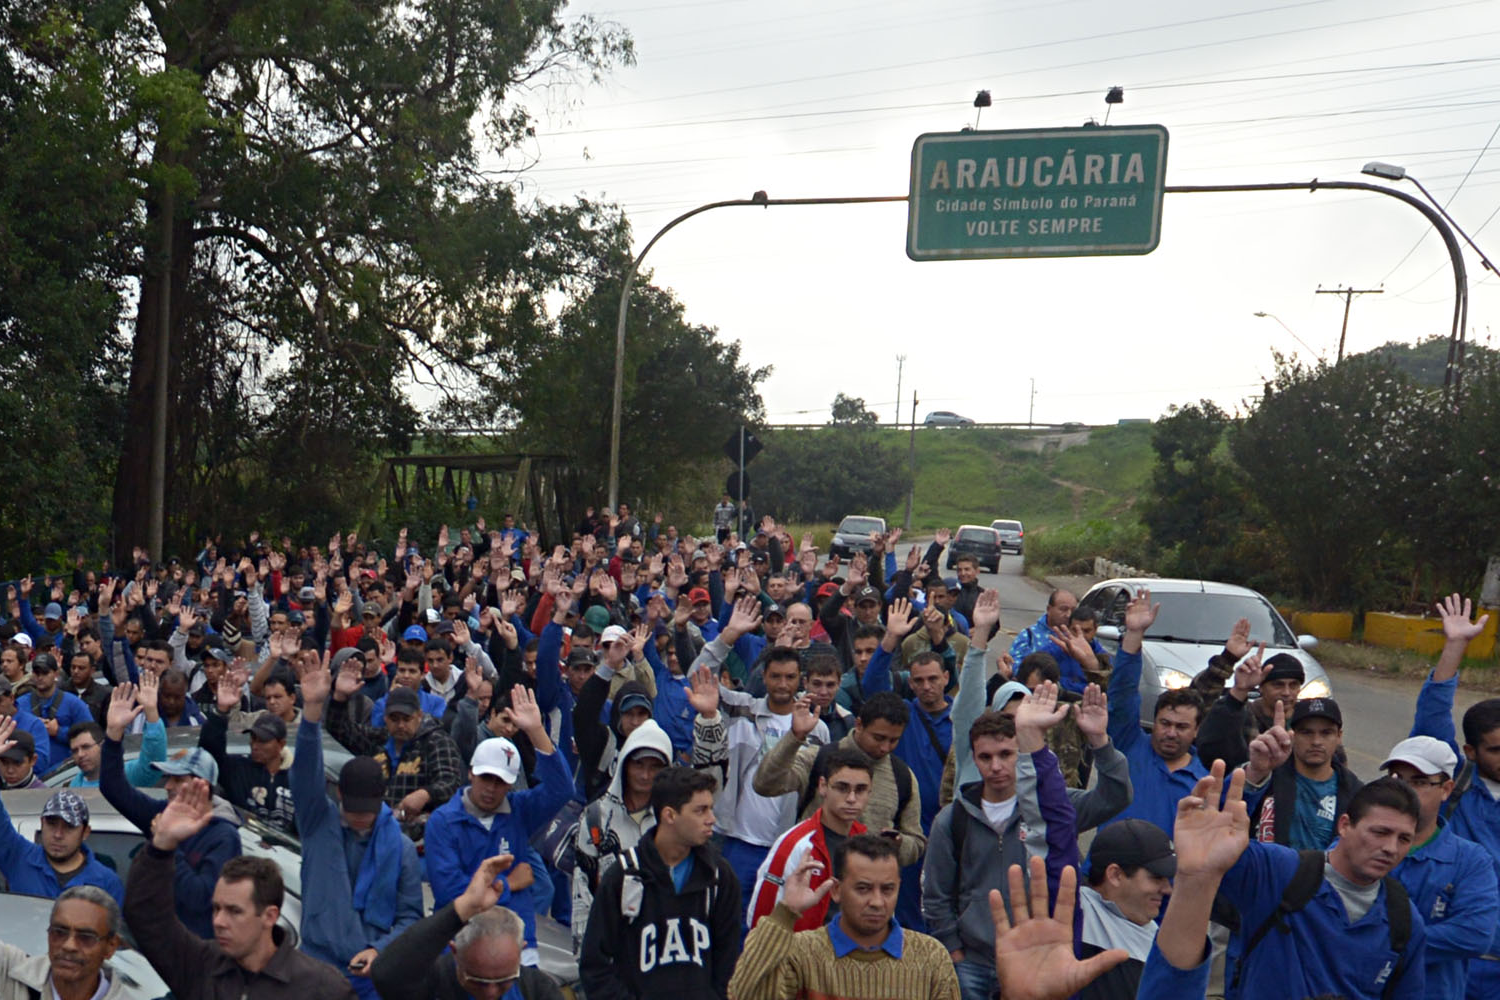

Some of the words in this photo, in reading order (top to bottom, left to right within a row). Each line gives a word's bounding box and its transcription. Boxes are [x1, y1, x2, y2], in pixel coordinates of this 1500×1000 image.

[929, 149, 1145, 190] ARAUCÁRIA
[936, 197, 987, 212] Cidade
[1060, 195, 1078, 209] do
[1084, 194, 1137, 208] Paraná
[966, 219, 1020, 237] VOLTE
[1028, 217, 1103, 235] SEMPRE
[639, 917, 711, 973] GAP
